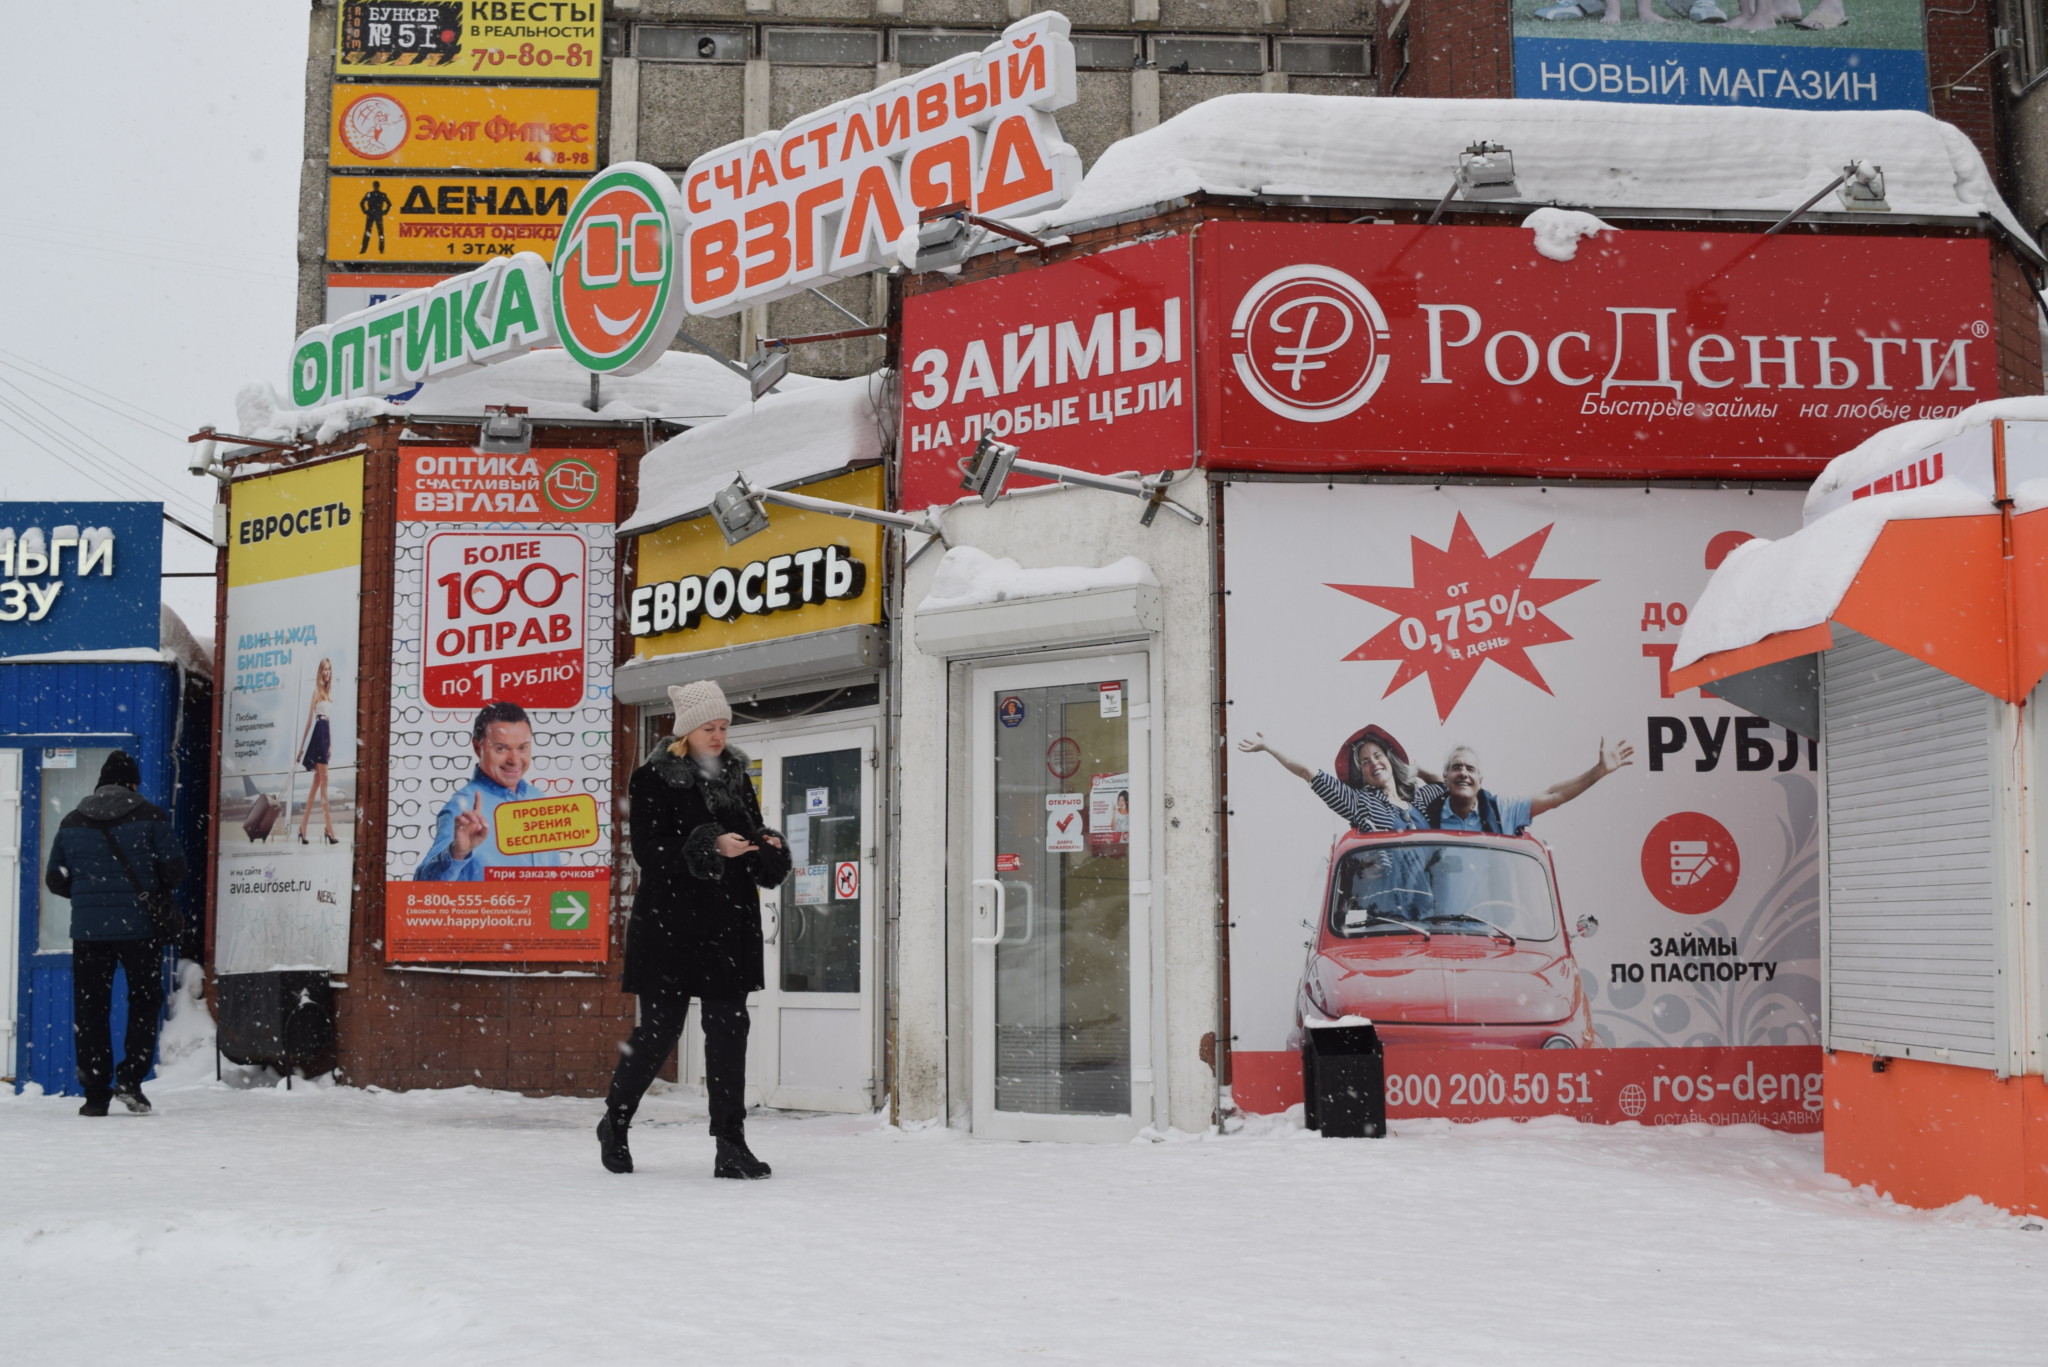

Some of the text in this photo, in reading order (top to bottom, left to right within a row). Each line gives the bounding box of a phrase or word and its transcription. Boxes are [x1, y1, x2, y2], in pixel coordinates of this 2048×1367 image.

[368, 6, 440, 22] БУНКЕР
[471, 1, 595, 22] КВЕСТЫ
[470, 25, 594, 38] В РЕАЛЬНОСТИ
[470, 42, 593, 72] 70-80-81
[1539, 60, 1878, 102] НОВЫЙ МАГАЗИН
[415, 115, 589, 144] Элит Фитнес
[687, 32, 1047, 215] СЧАСТЛИВЫЙ
[525, 151, 589, 165] 448-98
[400, 185, 568, 216] ДЕНДИ
[690, 115, 1054, 305] ВЗГЛЯД
[399, 227, 486, 239] МУЖСКАЯ
[447, 243, 516, 255] 1 ЭТАЖ
[291, 267, 540, 408] ОПТИКА
[911, 296, 1182, 411] ЗАЙМЫ
[911, 377, 1182, 452] НА ЛЮБЫЕ ЦЕЛИ
[1580, 392, 1695, 422] Быстрые
[1701, 396, 1779, 418] займы
[1799, 403, 1828, 418] на
[1835, 396, 1912, 420] любые
[415, 456, 540, 477] ОПТИКА
[415, 477, 540, 490] СЧАСТЛИВЫЙ
[414, 492, 540, 512] ВЗГЛЯД
[239, 502, 352, 545] ЕВРОСЕТЬ
[464, 541, 541, 565] БОЛЕЕ
[630, 544, 853, 636] ЕВРОСЕТЬ
[1399, 587, 1536, 654] 0,75%
[238, 624, 317, 651] АВИА И Ж/Д
[436, 613, 573, 657] ОПРАВ
[1450, 637, 1509, 659] в день
[236, 649, 292, 671] БИЛЕТЫ
[236, 671, 280, 694] ЗДЕСЬ
[473, 663, 494, 700] 1
[512, 803, 579, 819] ПРОВЕРКА
[523, 818, 572, 832] ЗРЕНИЯ
[795, 865, 827, 877] НА СЕБЯ
[230, 877, 311, 895] avia.euroset.ru
[406, 915, 532, 929] www.happylook.ru
[451, 907, 479, 915] России
[1649, 932, 1738, 957] ЗАЙМЫ
[1611, 962, 1778, 982] ПО ПАСПОРТУ
[1450, 1073, 1505, 1105] 200
[1513, 1072, 1549, 1104] 50
[1557, 1072, 1593, 1103] 51
